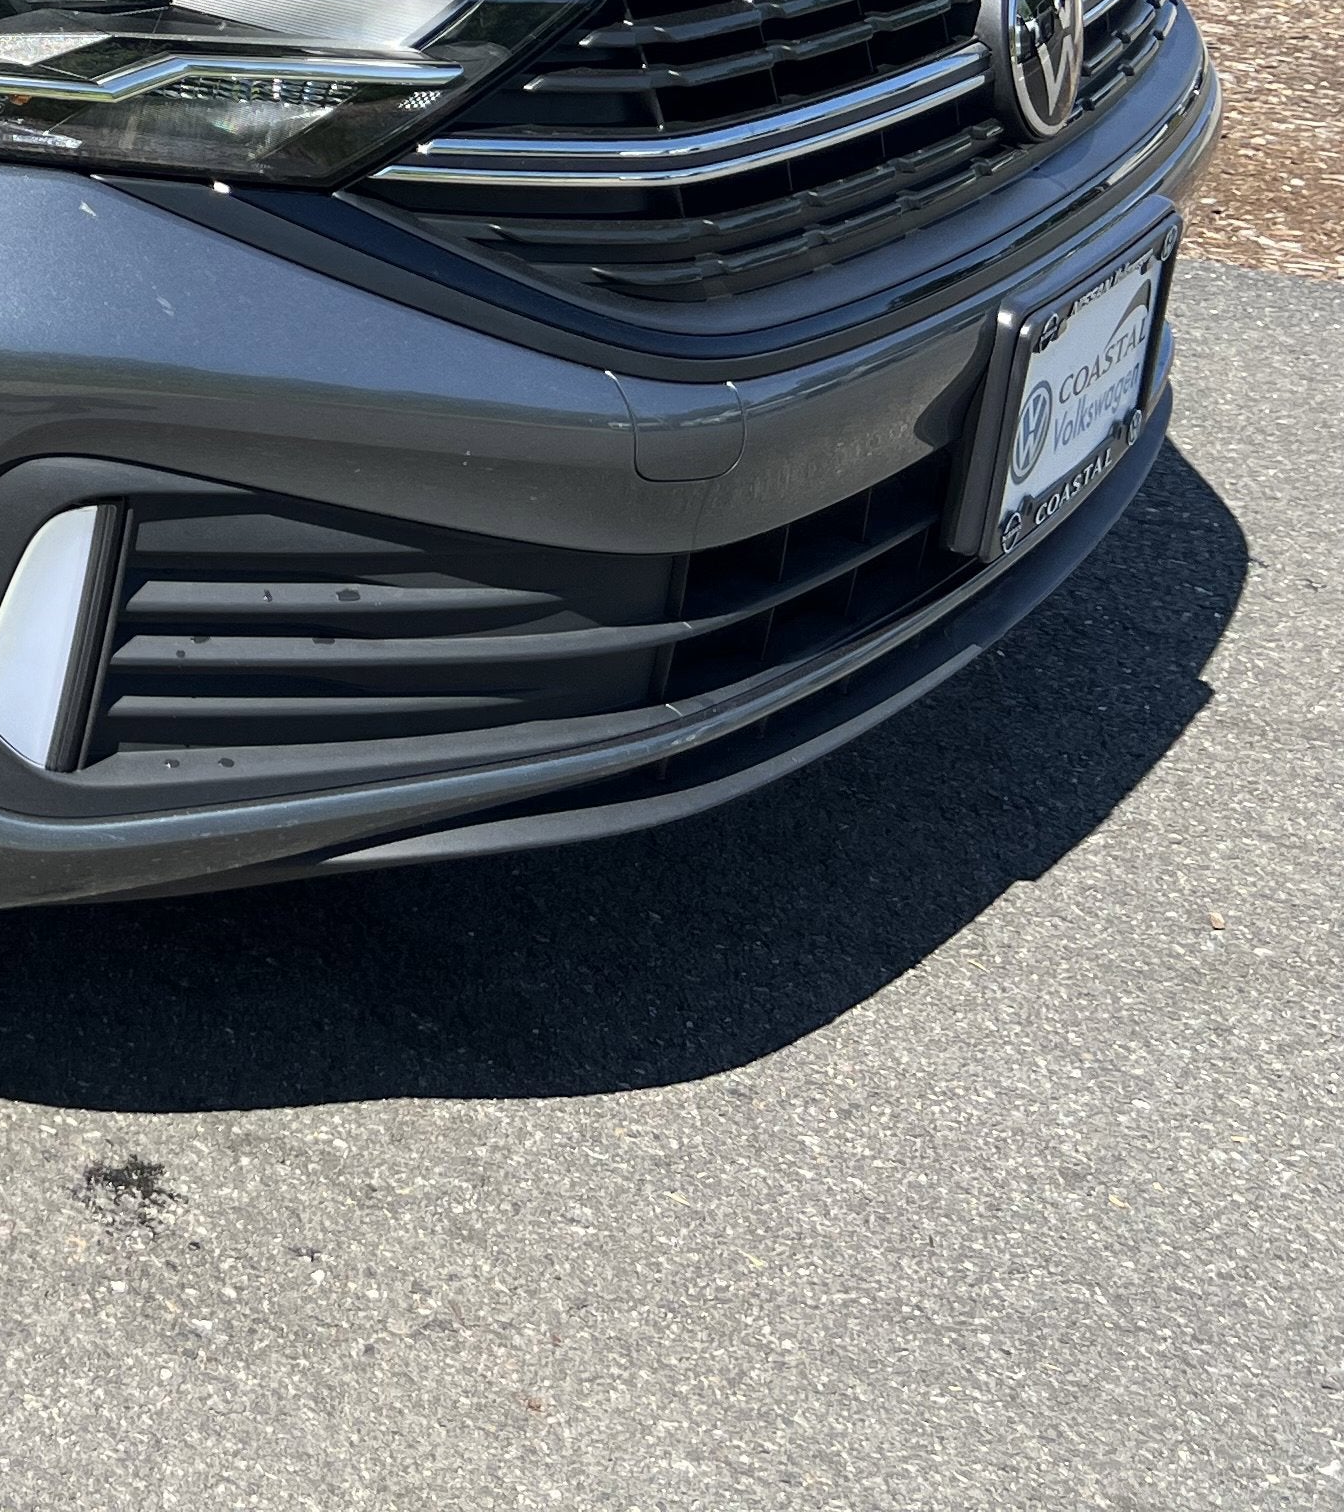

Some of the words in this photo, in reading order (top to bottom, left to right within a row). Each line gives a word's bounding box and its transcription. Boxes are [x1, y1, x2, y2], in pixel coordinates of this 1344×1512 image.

[1058, 318, 1147, 404] COASTAL
[1052, 362, 1140, 452] Volkswagen
[1033, 447, 1113, 526] COASTAL
